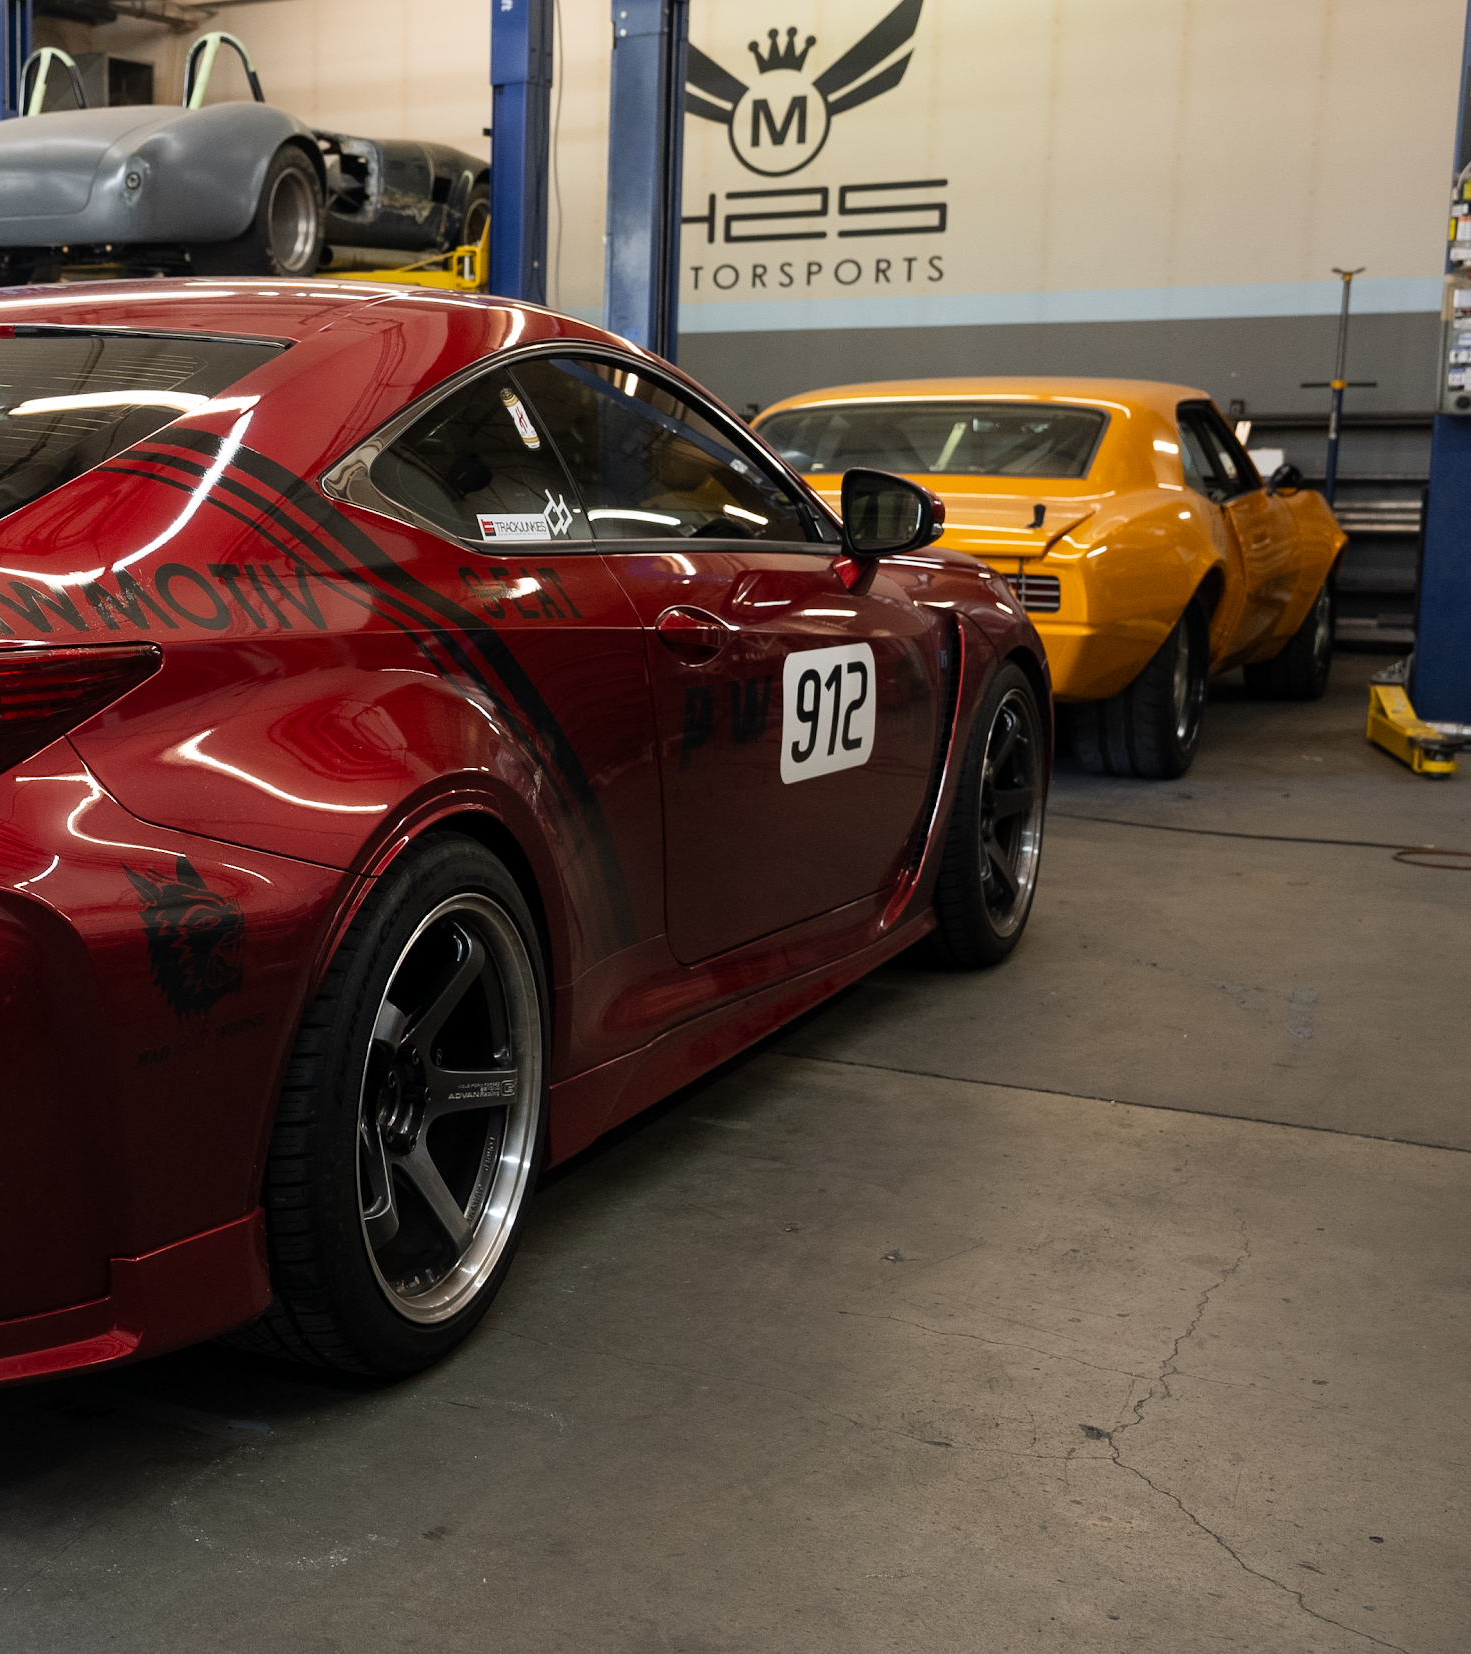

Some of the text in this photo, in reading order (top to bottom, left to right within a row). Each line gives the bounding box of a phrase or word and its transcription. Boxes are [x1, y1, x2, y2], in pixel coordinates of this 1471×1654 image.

[750, 95, 808, 148] M
[495, 521, 547, 532] TRACKJUNKIES
[791, 661, 868, 763] 912
